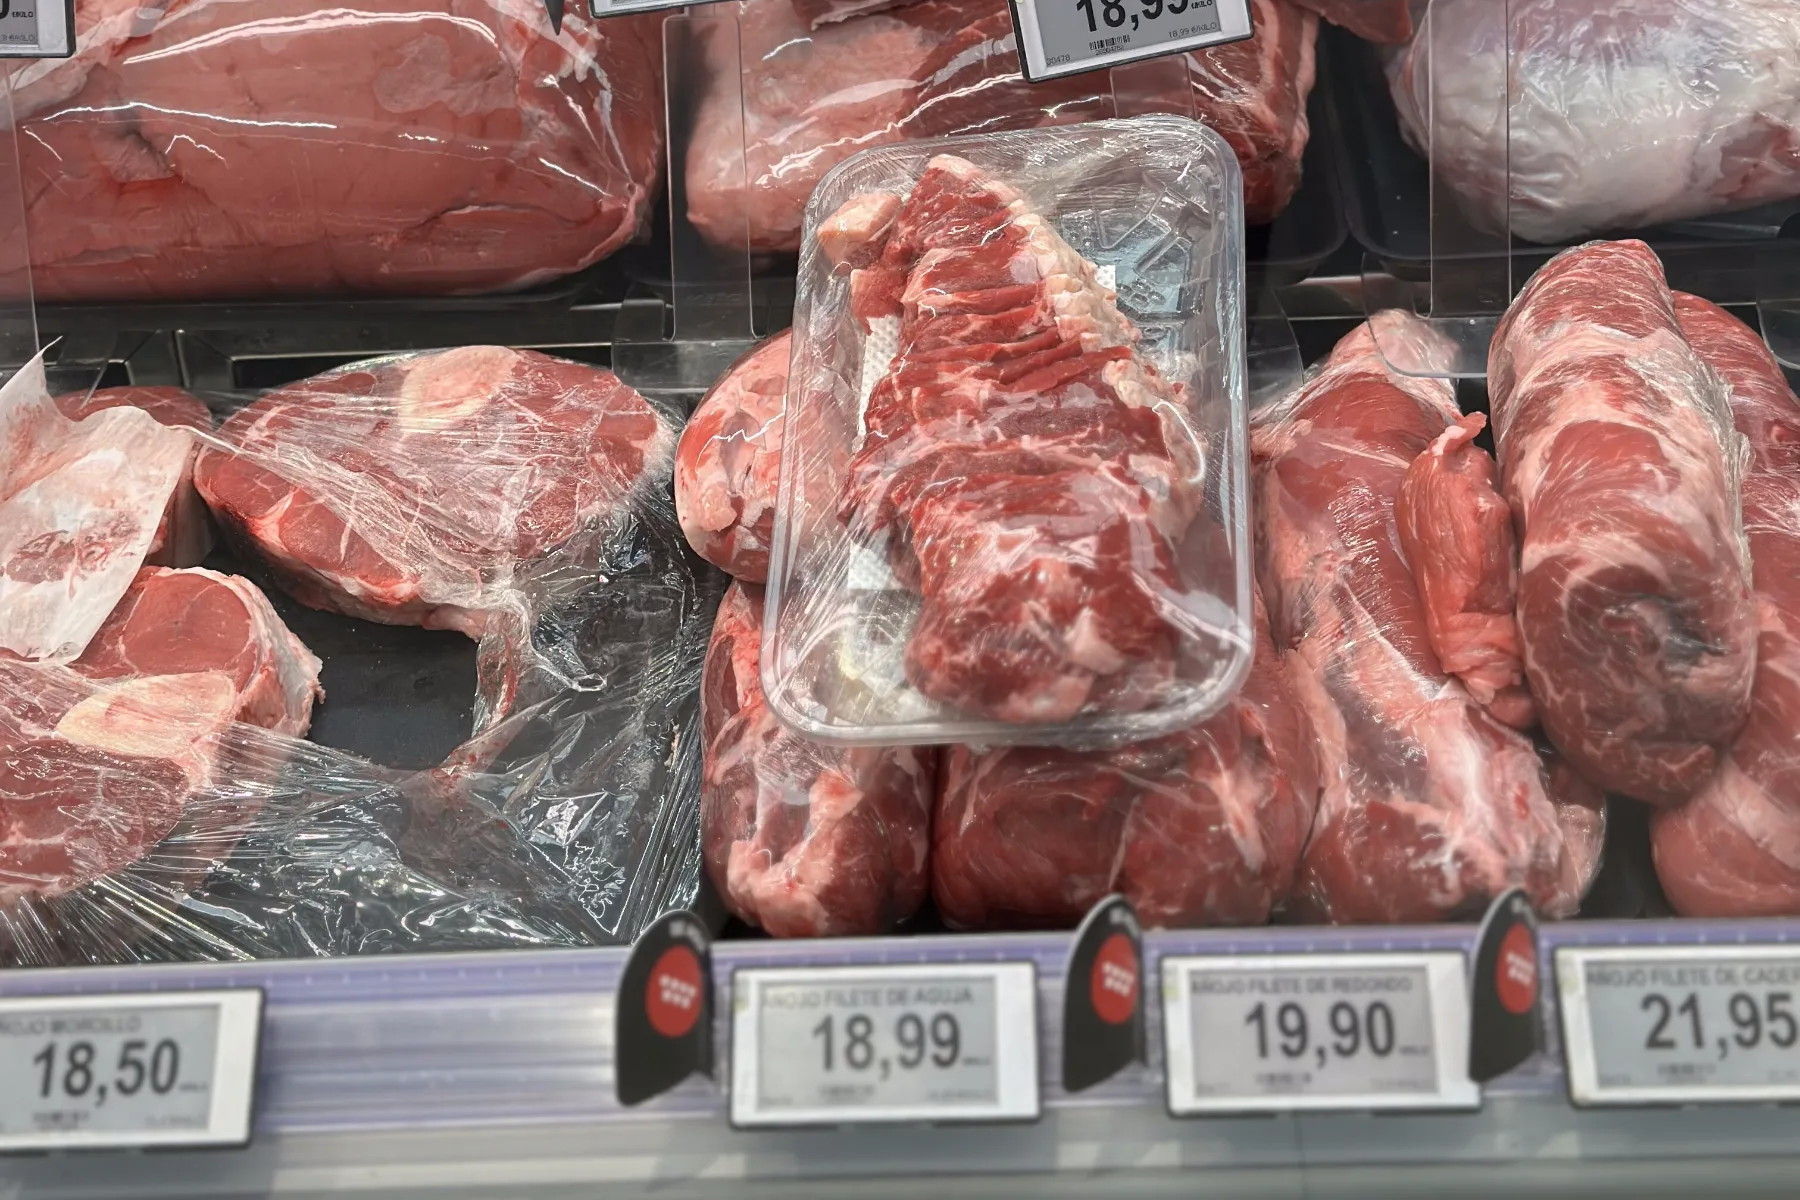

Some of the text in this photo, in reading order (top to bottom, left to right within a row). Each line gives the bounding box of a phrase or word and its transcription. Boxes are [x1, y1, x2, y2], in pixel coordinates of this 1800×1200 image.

[812, 1011, 961, 1081] 18,99
[1245, 999, 1395, 1069] 19,90
[1641, 991, 1799, 1060] 21,95
[33, 1036, 181, 1107] 18,50
